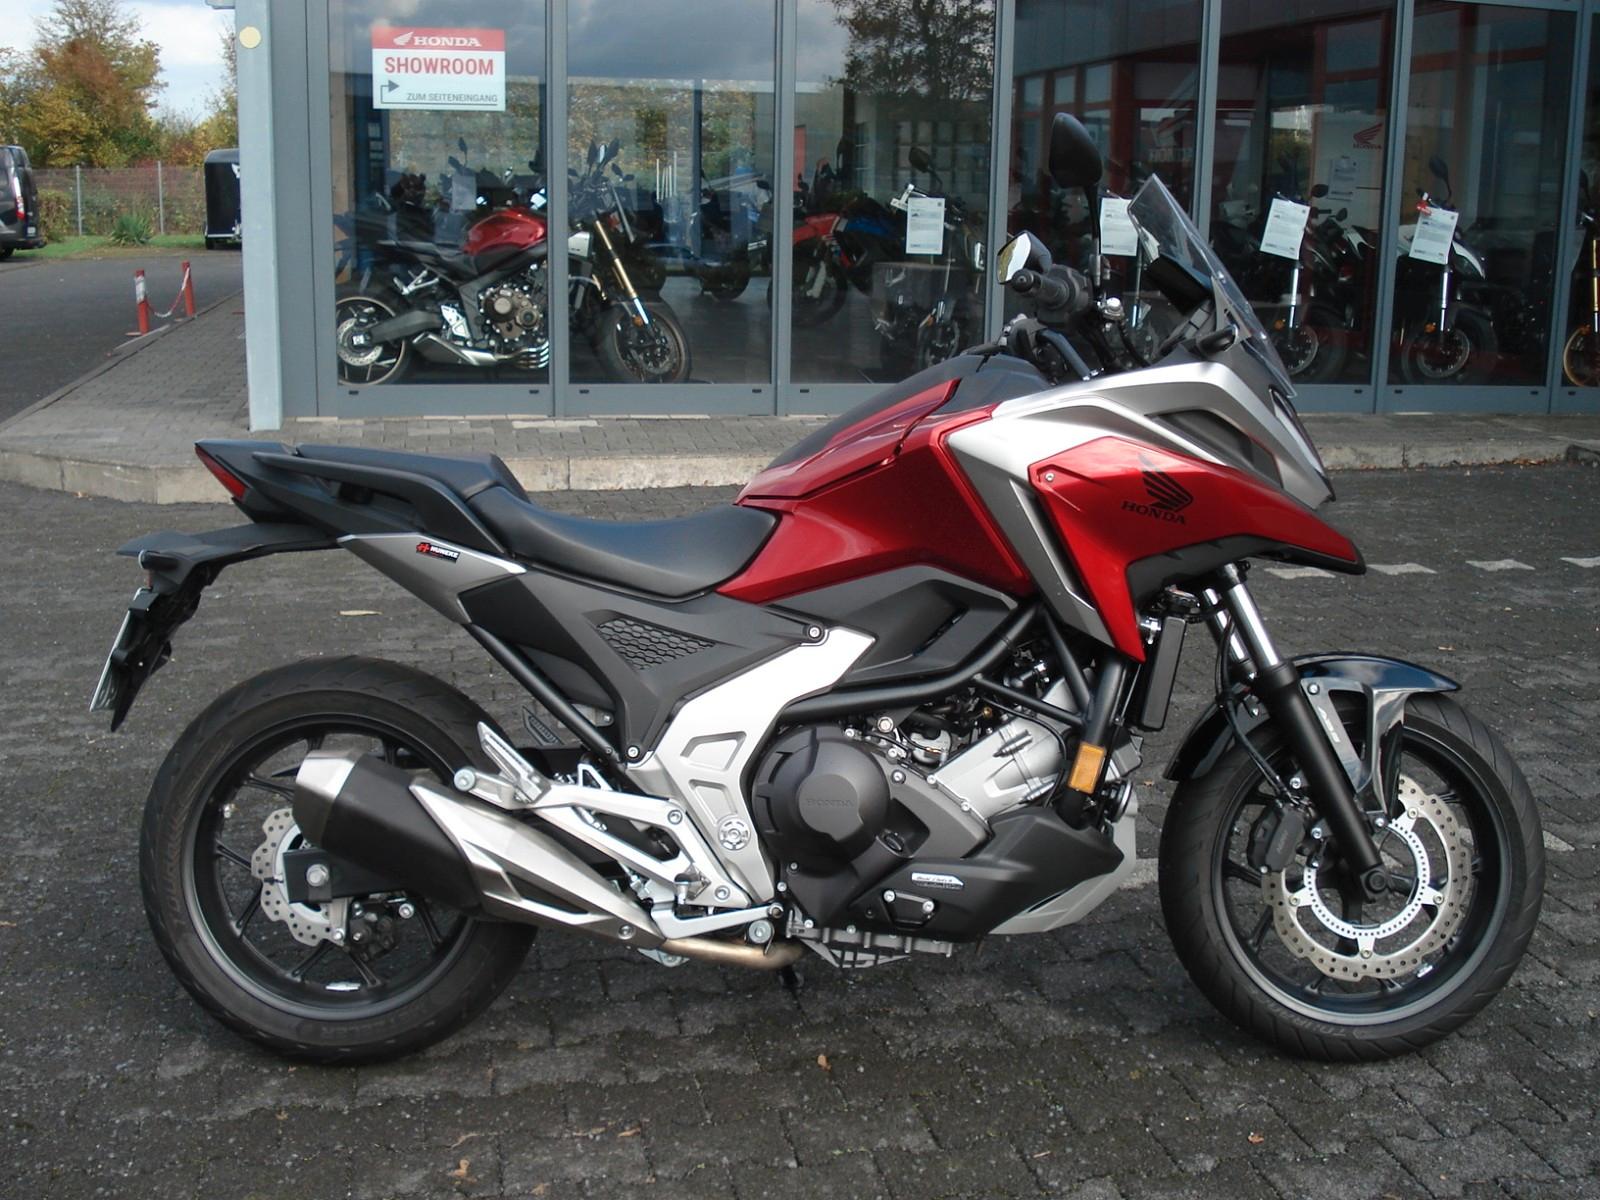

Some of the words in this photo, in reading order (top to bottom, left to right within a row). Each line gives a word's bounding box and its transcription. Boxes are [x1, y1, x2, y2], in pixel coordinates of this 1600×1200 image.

[413, 36, 482, 47] HONDA
[384, 56, 494, 75] SHOWROOM
[407, 92, 426, 101] ZUM
[429, 93, 498, 103] SEITENEINGANG
[1121, 501, 1185, 525] HONDA
